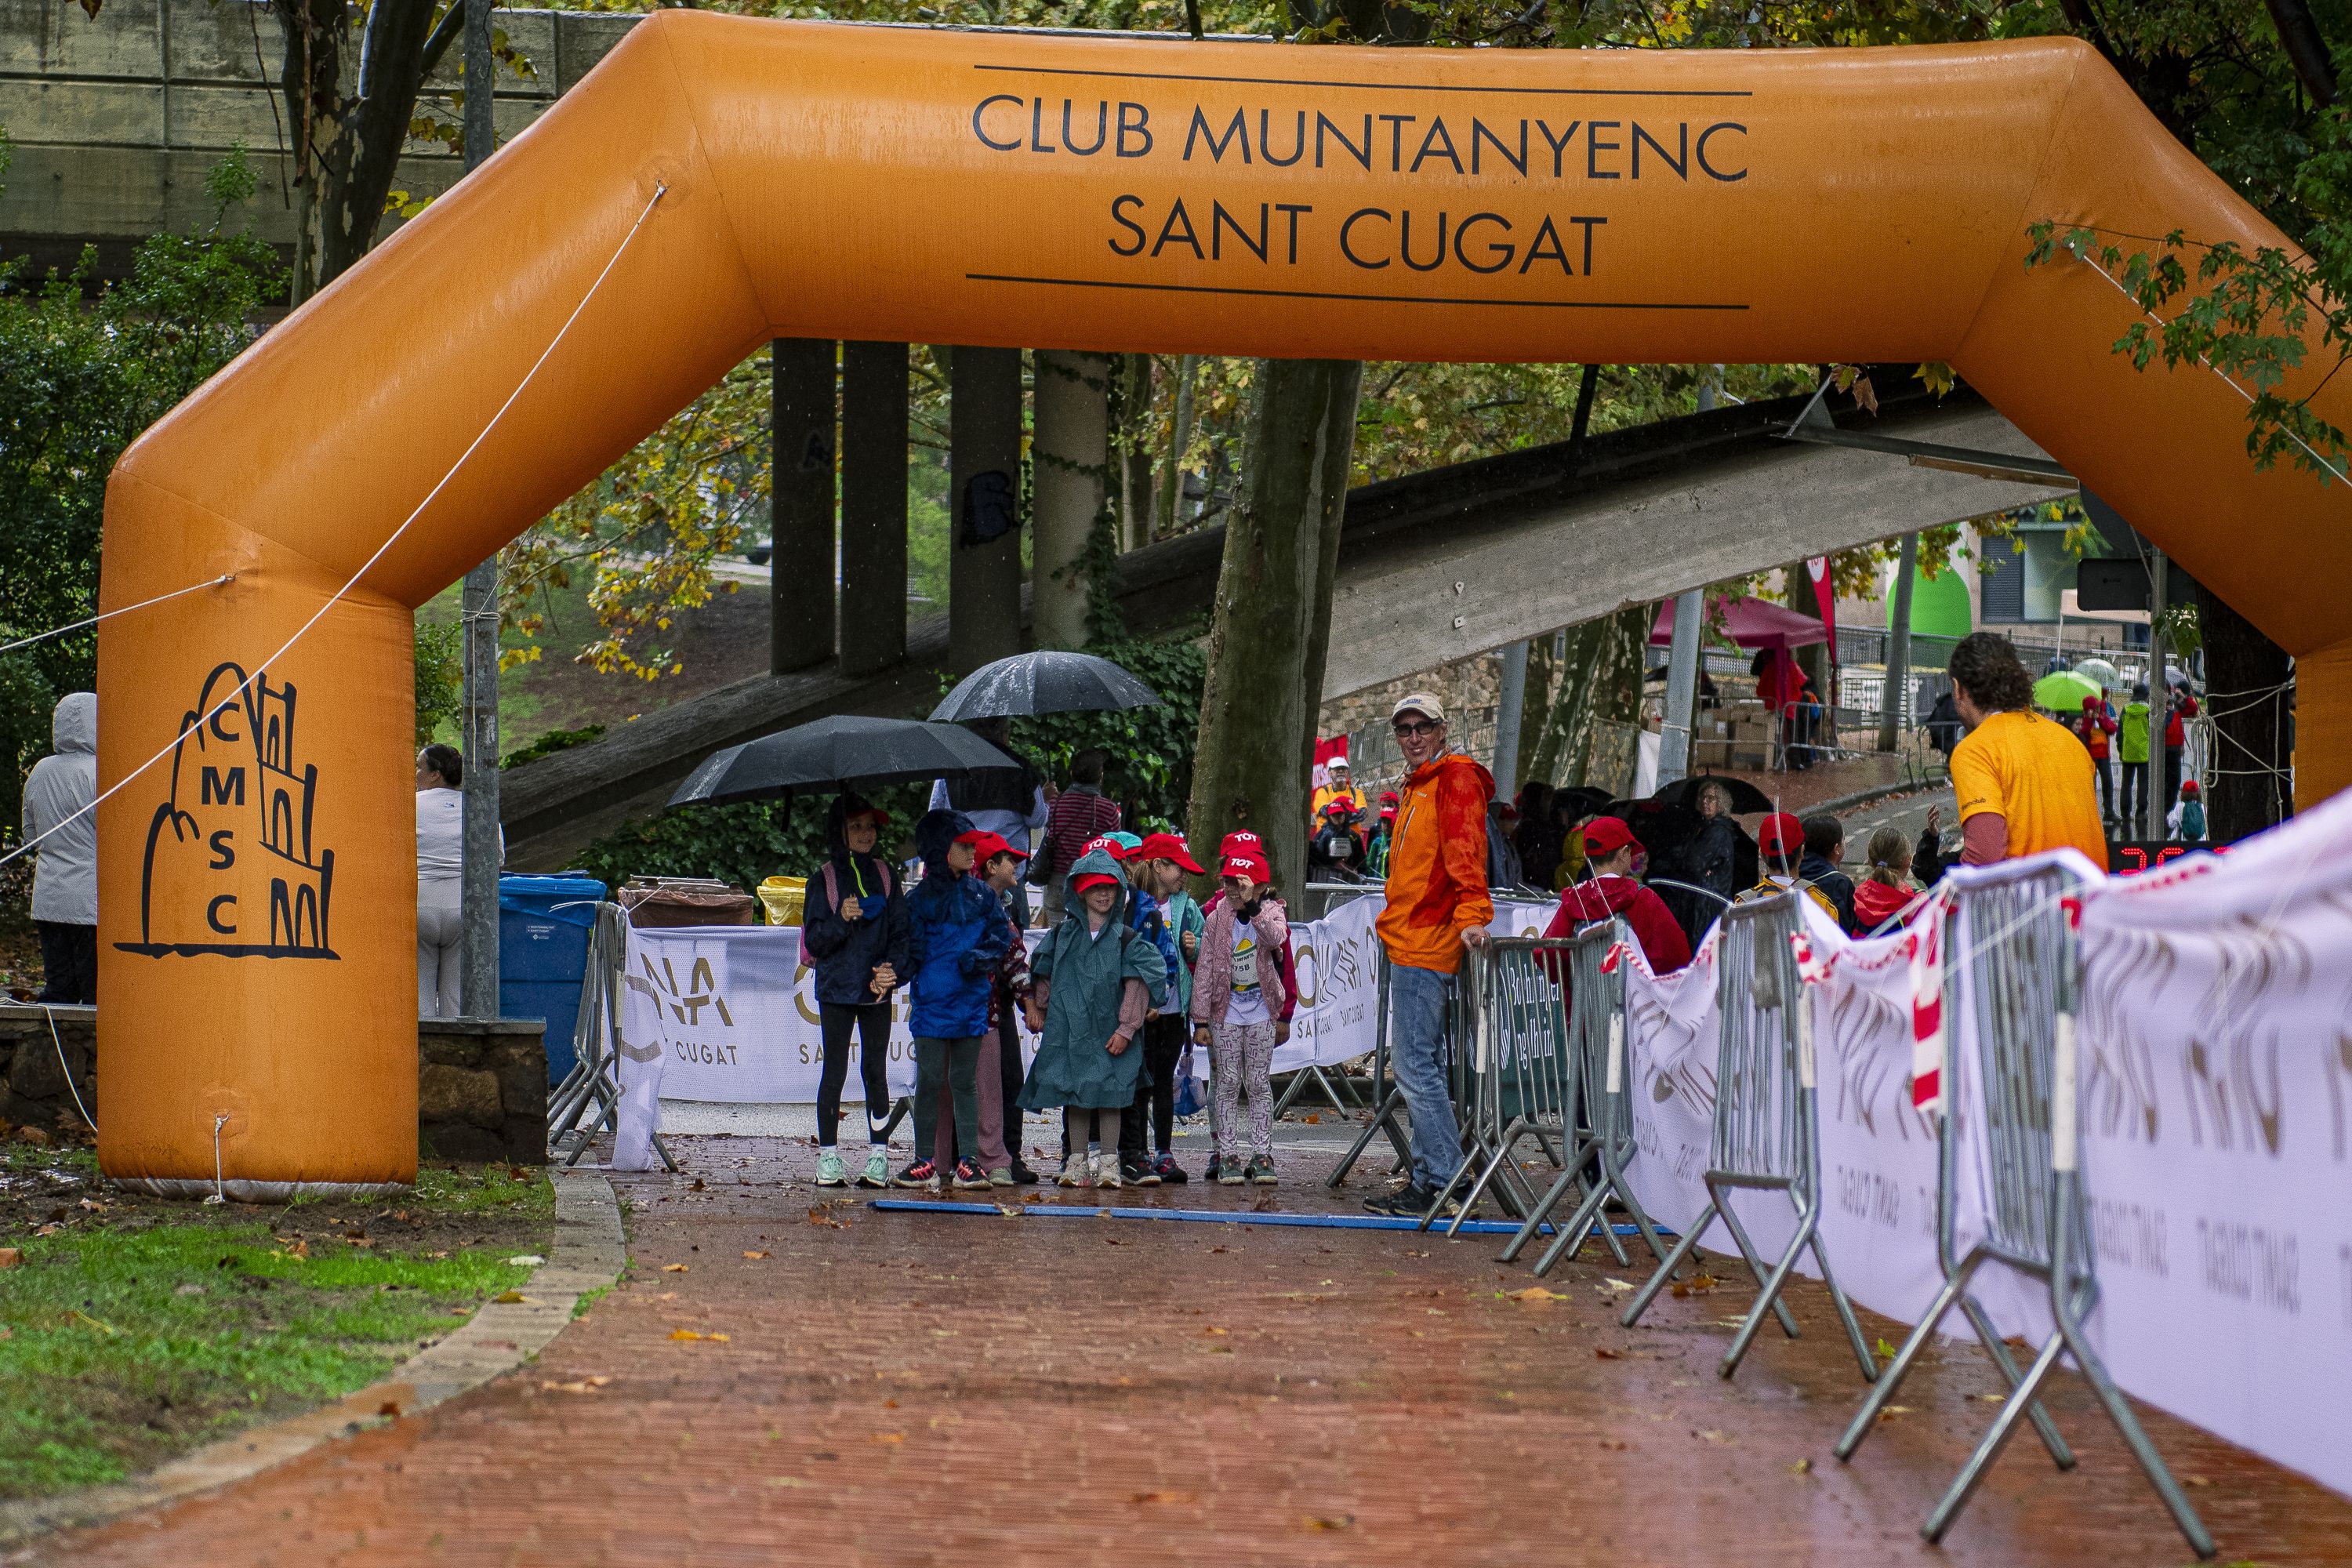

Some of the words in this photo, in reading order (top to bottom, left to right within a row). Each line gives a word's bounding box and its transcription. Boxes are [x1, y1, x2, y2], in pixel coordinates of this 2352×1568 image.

[973, 94, 1153, 158] CLUB
[1182, 103, 1748, 182] MUNTANYENC
[1108, 194, 1313, 265] SANT
[1339, 207, 1608, 277] CUGAT
[1088, 838, 1111, 850] TOT
[1234, 833, 1257, 842] TOT
[1232, 858, 1254, 869] TOT
[675, 1040, 737, 1065] CUGAT
[798, 1043, 859, 1064] SAT
